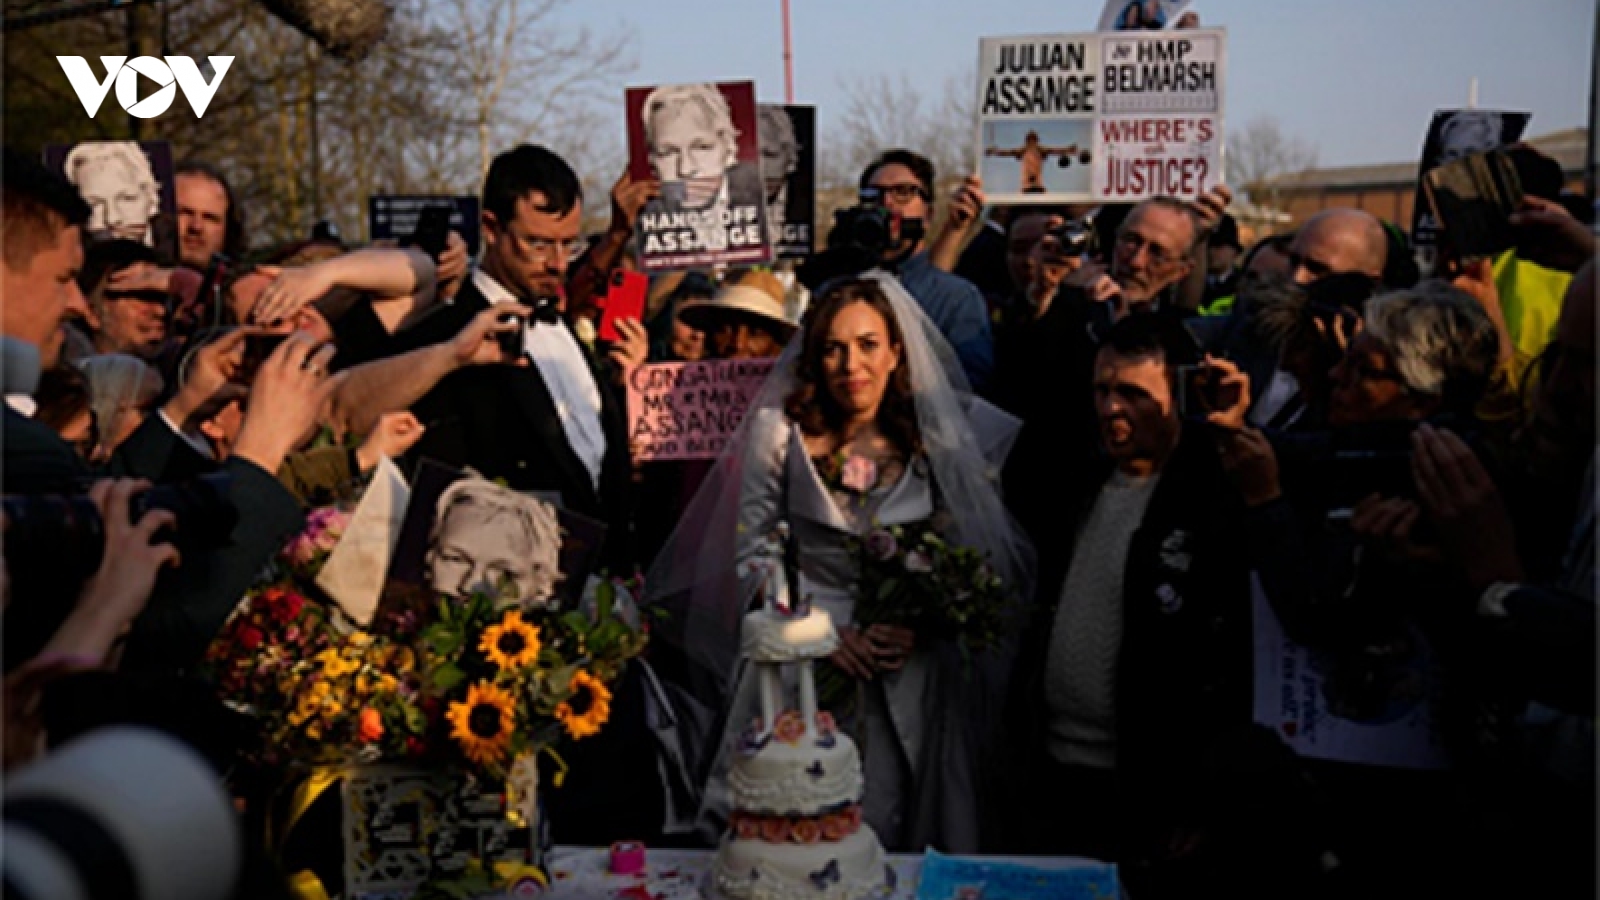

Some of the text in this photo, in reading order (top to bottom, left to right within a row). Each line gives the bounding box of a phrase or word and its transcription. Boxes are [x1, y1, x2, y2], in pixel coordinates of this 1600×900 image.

[996, 42, 1086, 73] JULIAN
[1137, 40, 1193, 62] HMP
[1104, 62, 1216, 93] BELMARSH
[982, 75, 1096, 113] ASSANGE
[1101, 119, 1214, 143] WHERE'S
[1103, 156, 1208, 196] JUSTICE?
[636, 405, 744, 437] ASSANG
